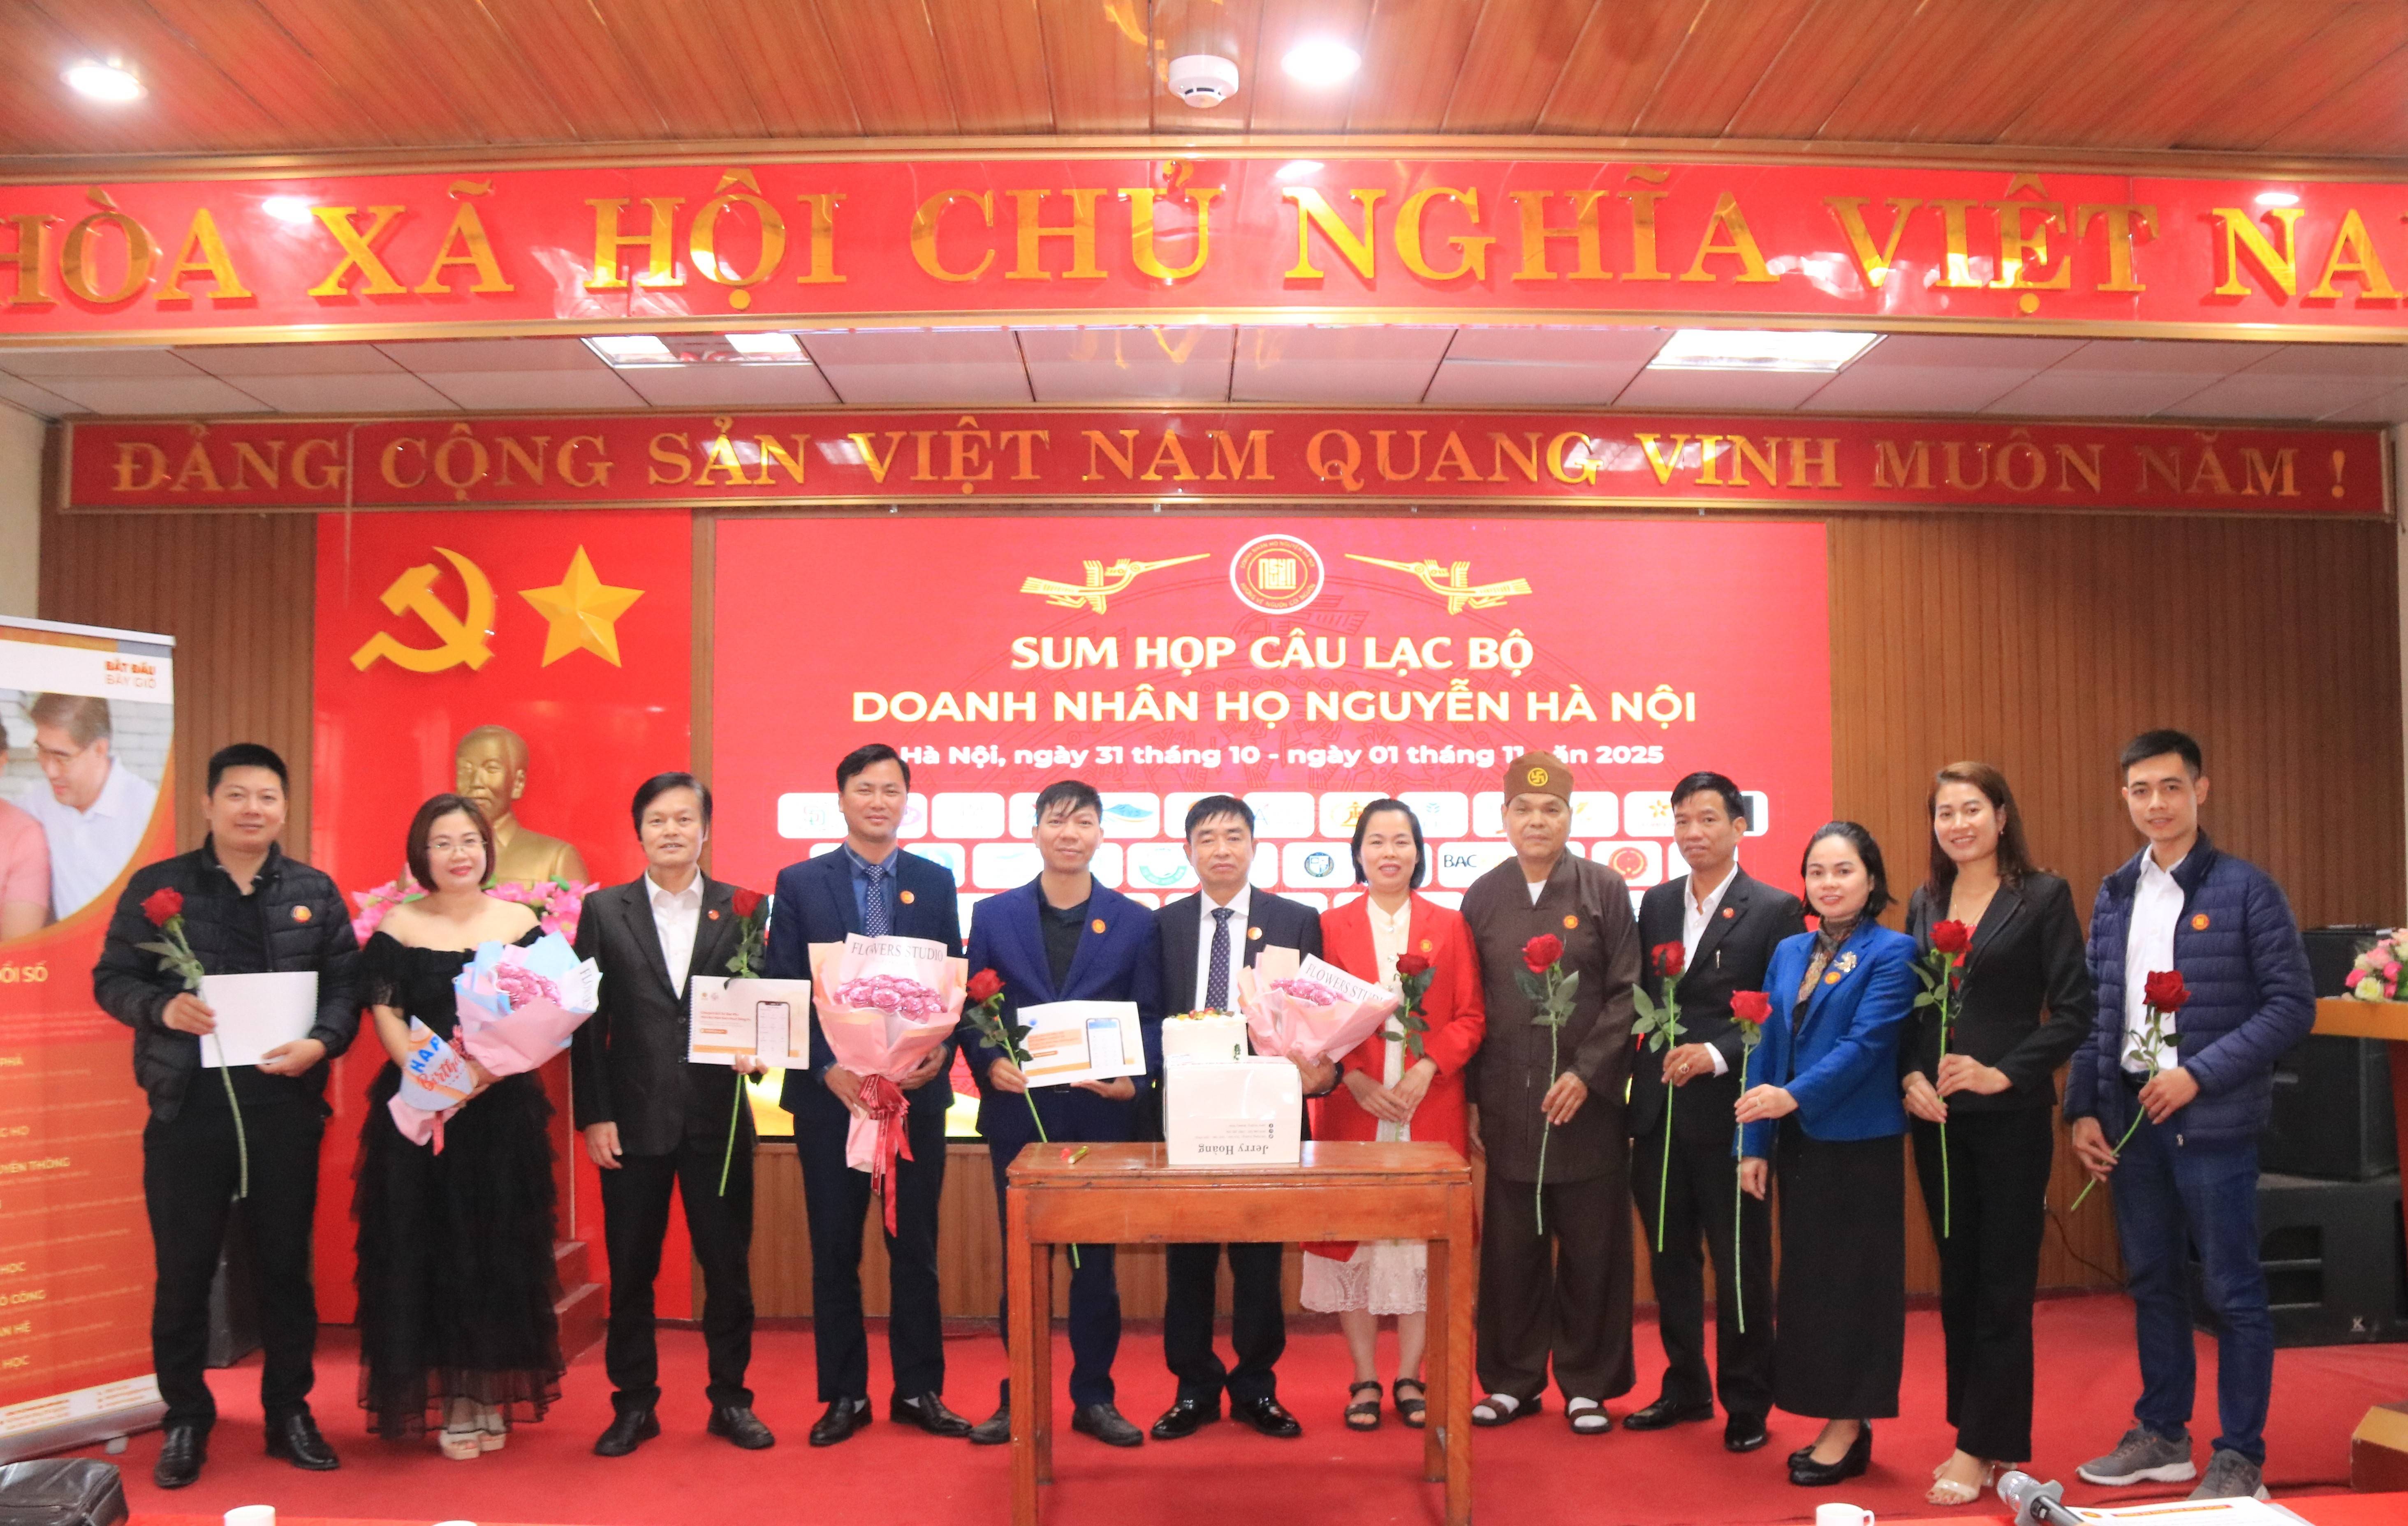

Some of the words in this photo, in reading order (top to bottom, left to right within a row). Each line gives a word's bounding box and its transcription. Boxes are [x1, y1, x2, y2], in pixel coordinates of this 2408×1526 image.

[306, 179, 514, 296] XÃ
[583, 168, 847, 311] HỘI
[910, 160, 1224, 282] CHỦ
[1282, 164, 1780, 284] NGHĨA
[1824, 172, 2159, 314] VIỆT
[2211, 208, 2408, 299] NA
[112, 423, 345, 492] ĐẢNG
[381, 422, 614, 501] CỘNG
[648, 415, 810, 488] SẢN
[848, 416, 1049, 495] VIỆT
[1081, 429, 1275, 481] NAM
[1306, 429, 1603, 491] QUANG
[1635, 433, 1836, 488] VINH
[1874, 428, 2104, 492] MUÔN
[2137, 431, 2301, 496] NĂM
[1011, 636, 1118, 670] SUM
[1135, 636, 1236, 677] HỌP
[1250, 627, 1347, 669] CÂU
[1364, 636, 1454, 677] LẠC
[1468, 628, 1534, 677] BỘ
[852, 691, 1037, 722] DOANH
[1054, 683, 1199, 722] NHÂN
[1216, 691, 1291, 729] HỌ
[1306, 678, 1510, 722] NGUYỄN
[1526, 683, 1598, 722] HÀ
[1610, 683, 1696, 730] NỘI
[901, 745, 940, 764] Hà
[949, 745, 1006, 769] Nội,
[1014, 745, 1091, 769] ngày
[1095, 745, 1124, 764] 31
[1132, 745, 1221, 768] tháng
[1229, 745, 1260, 764] 10
[1287, 745, 1361, 769] ngày
[1368, 745, 1398, 764] 01
[1406, 745, 1495, 768] tháng
[1595, 745, 1664, 764] 2025
[1444, 854, 1477, 867] BAC
[905, 945, 943, 962] STUDIO
[1306, 963, 1351, 994] FLOWERS
[1198, 1143, 1234, 1156] Hoàng
[1237, 1143, 1269, 1154] Jerry
